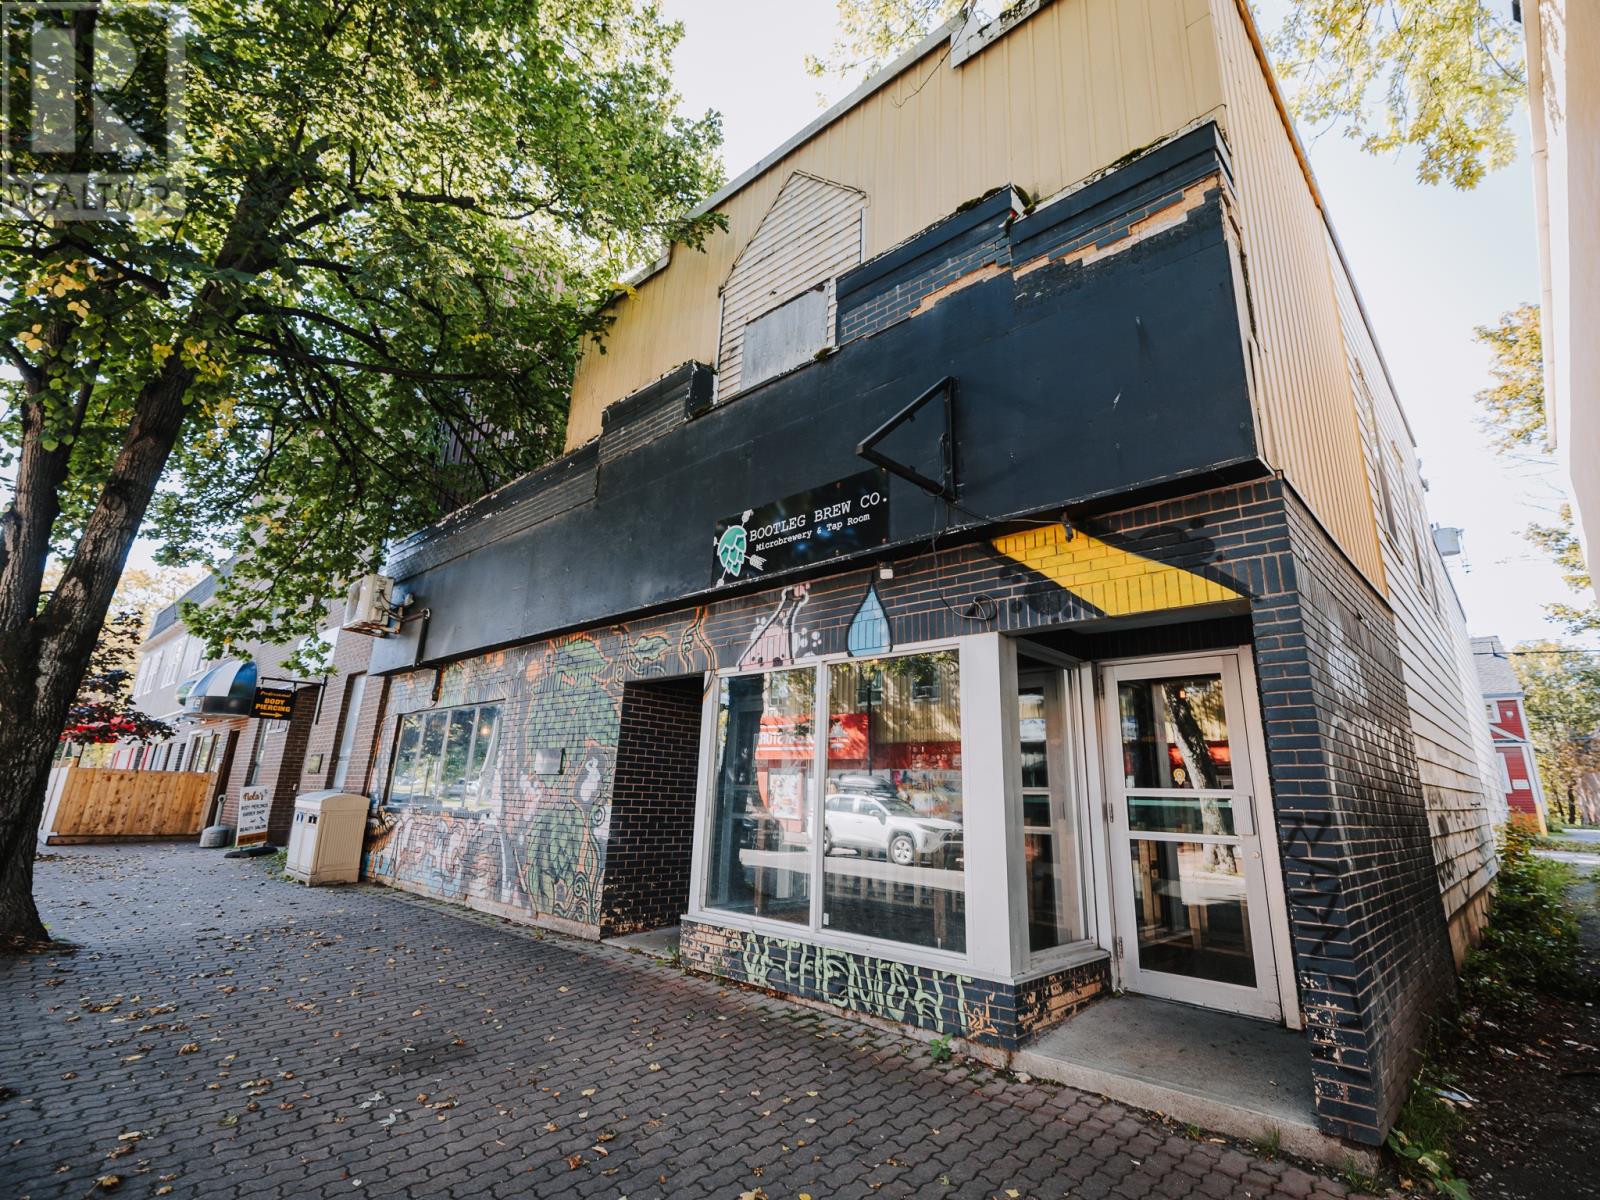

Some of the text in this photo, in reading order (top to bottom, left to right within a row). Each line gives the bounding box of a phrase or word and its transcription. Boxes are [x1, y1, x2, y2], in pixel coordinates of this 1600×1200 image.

[749, 492, 888, 542] BOOTLEG BREW CO.
[755, 529, 813, 551] Microbrewery
[826, 520, 843, 532] Tap
[847, 513, 870, 526] Room
[255, 704, 291, 712] PIERCING
